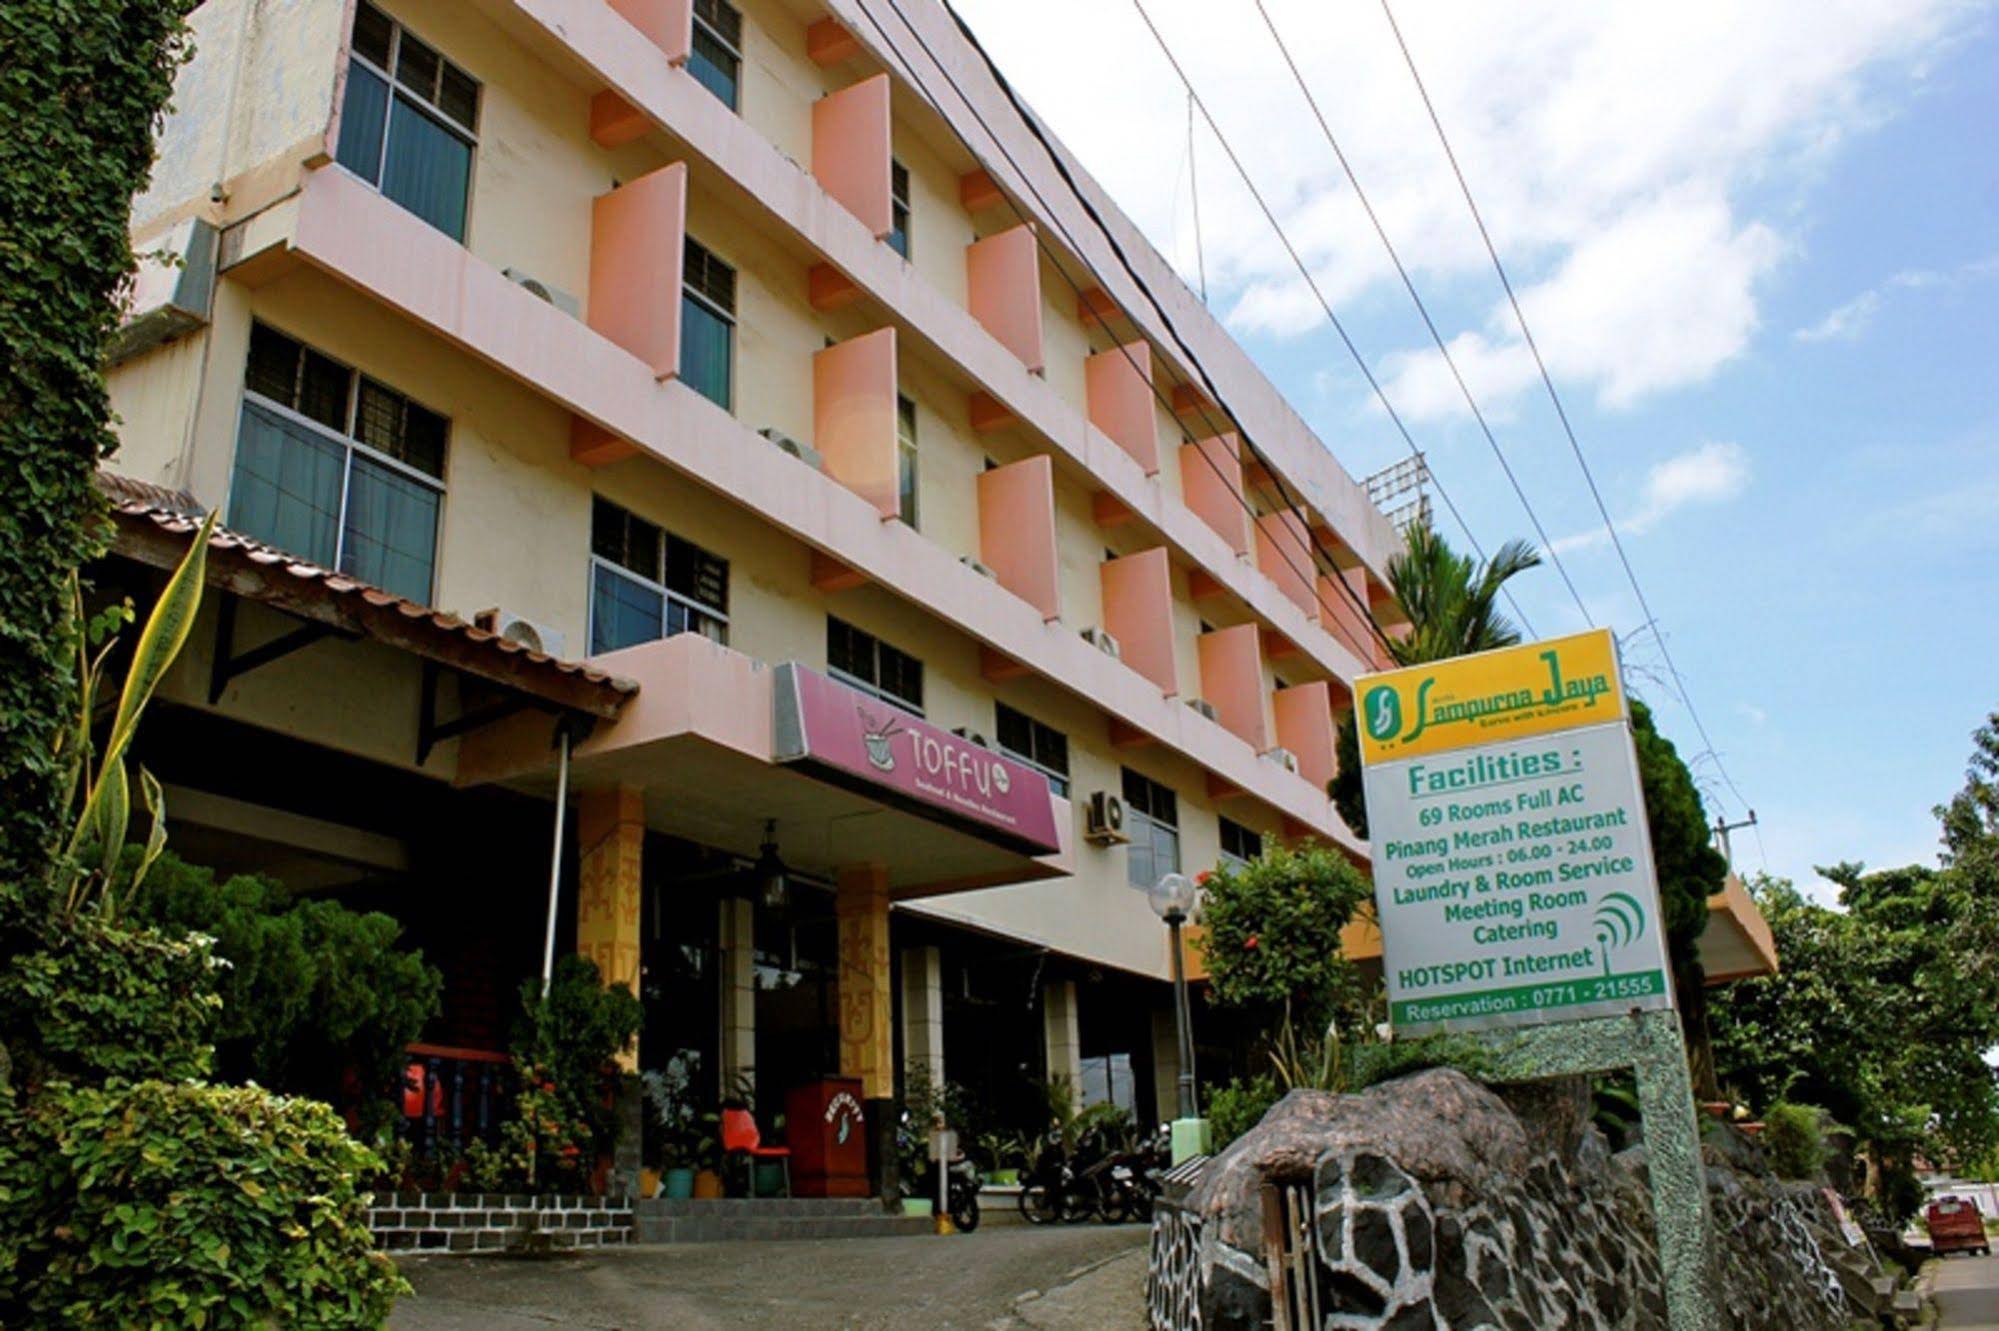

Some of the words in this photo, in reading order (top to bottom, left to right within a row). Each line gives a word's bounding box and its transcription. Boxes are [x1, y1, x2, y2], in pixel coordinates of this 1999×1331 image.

[1402, 677, 1533, 744] Sampurna
[1539, 650, 1611, 708] Jaya
[1408, 751, 1561, 795] Facilities
[1419, 806, 1443, 827] 69
[1448, 799, 1513, 822] Rooms
[1517, 789, 1553, 811] Full
[1557, 784, 1585, 805] AC
[1385, 837, 1448, 861] Pinang
[1453, 825, 1513, 850] Merah
[1518, 807, 1627, 838] Restaurant
[1393, 878, 1470, 905] Laundry
[1475, 875, 1492, 894] &
[1496, 868, 1553, 891] Room
[1558, 854, 1634, 882] Service
[1406, 862, 1445, 880] Open
[1449, 853, 1493, 871] Hours
[1507, 844, 1551, 864] 06.00
[1567, 835, 1613, 856] 24.00
[1445, 897, 1523, 923] Meeting
[1529, 889, 1587, 911] Room
[1473, 919, 1558, 945] Catering
[1398, 959, 1496, 989] HOTSPOT
[1503, 947, 1594, 977] Internet
[1406, 993, 1516, 1021] Reservation
[1532, 985, 1577, 1008] 0771
[1595, 977, 1652, 998] 21555
